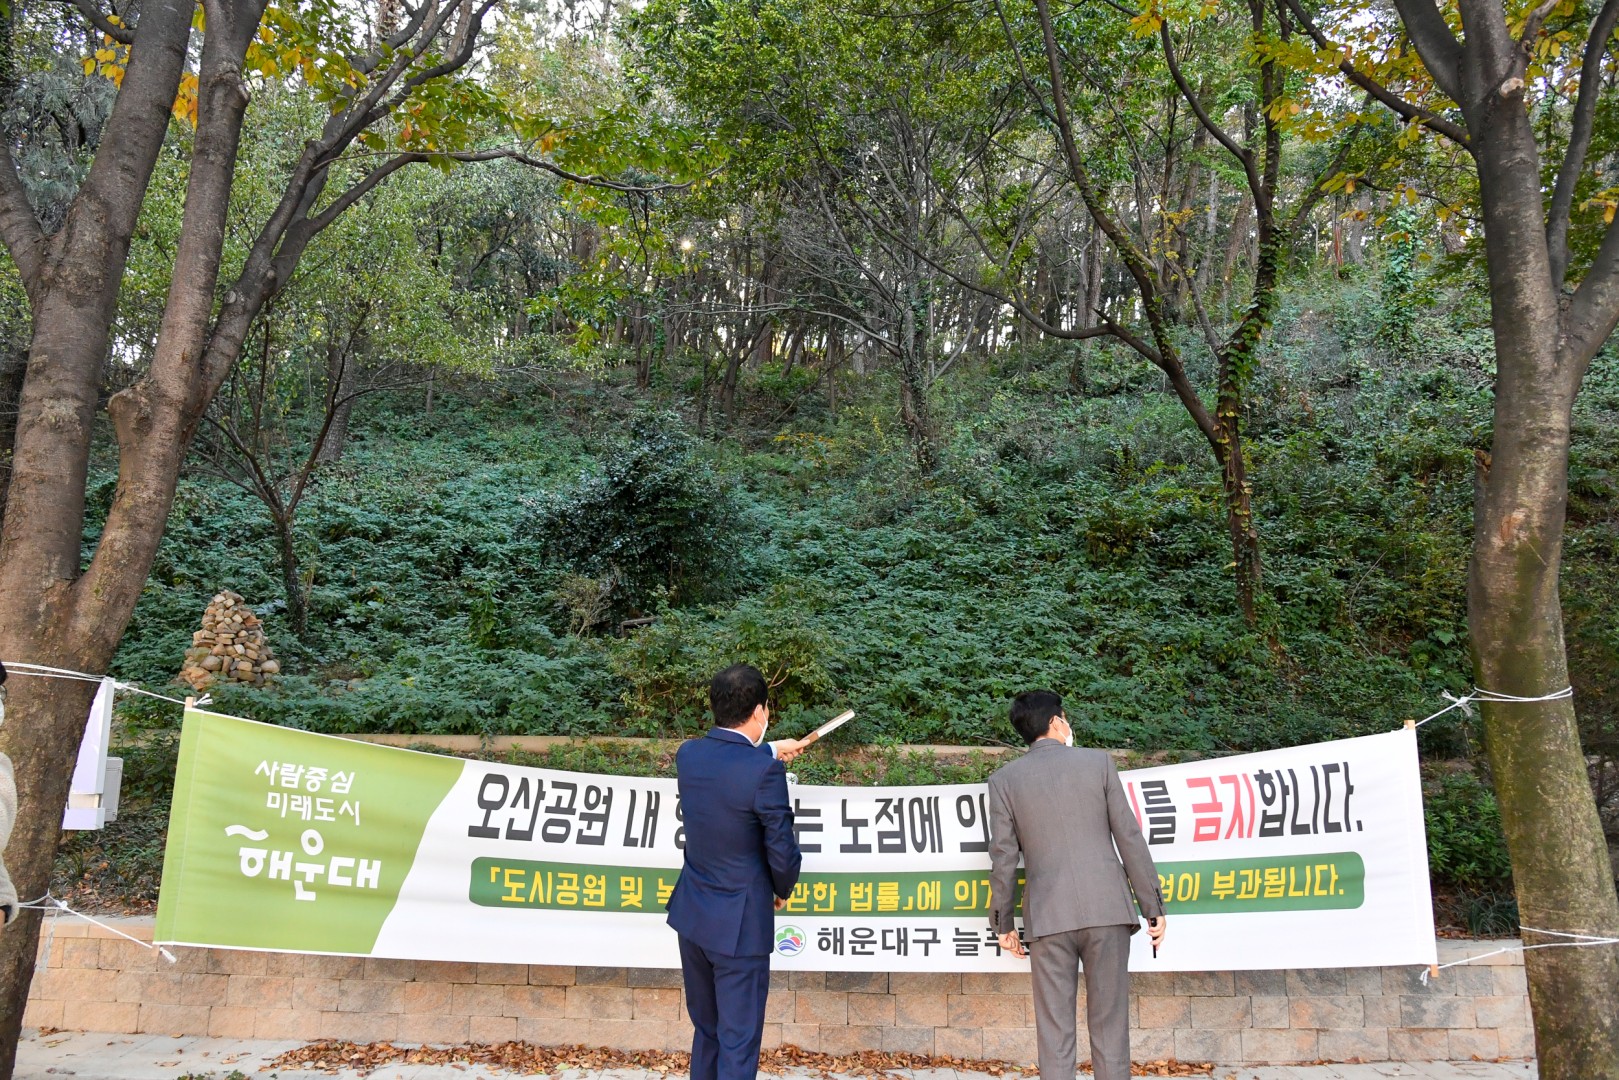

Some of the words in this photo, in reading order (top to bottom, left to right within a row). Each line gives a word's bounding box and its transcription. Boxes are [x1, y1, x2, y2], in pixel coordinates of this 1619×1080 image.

[255, 760, 355, 794] 사람중심
[266, 792, 360, 826] 미래도시
[468, 773, 613, 846] 오산공원
[623, 789, 660, 849] 내
[839, 796, 943, 854] 노점에
[956, 793, 991, 853] 의
[1186, 761, 1363, 842] 금지합니다.
[225, 824, 382, 901] 해운대
[620, 876, 643, 908] 및
[787, 882, 837, 912] 관한
[1211, 863, 1345, 900] 부과됩니다.
[817, 927, 941, 956] 해운대구
